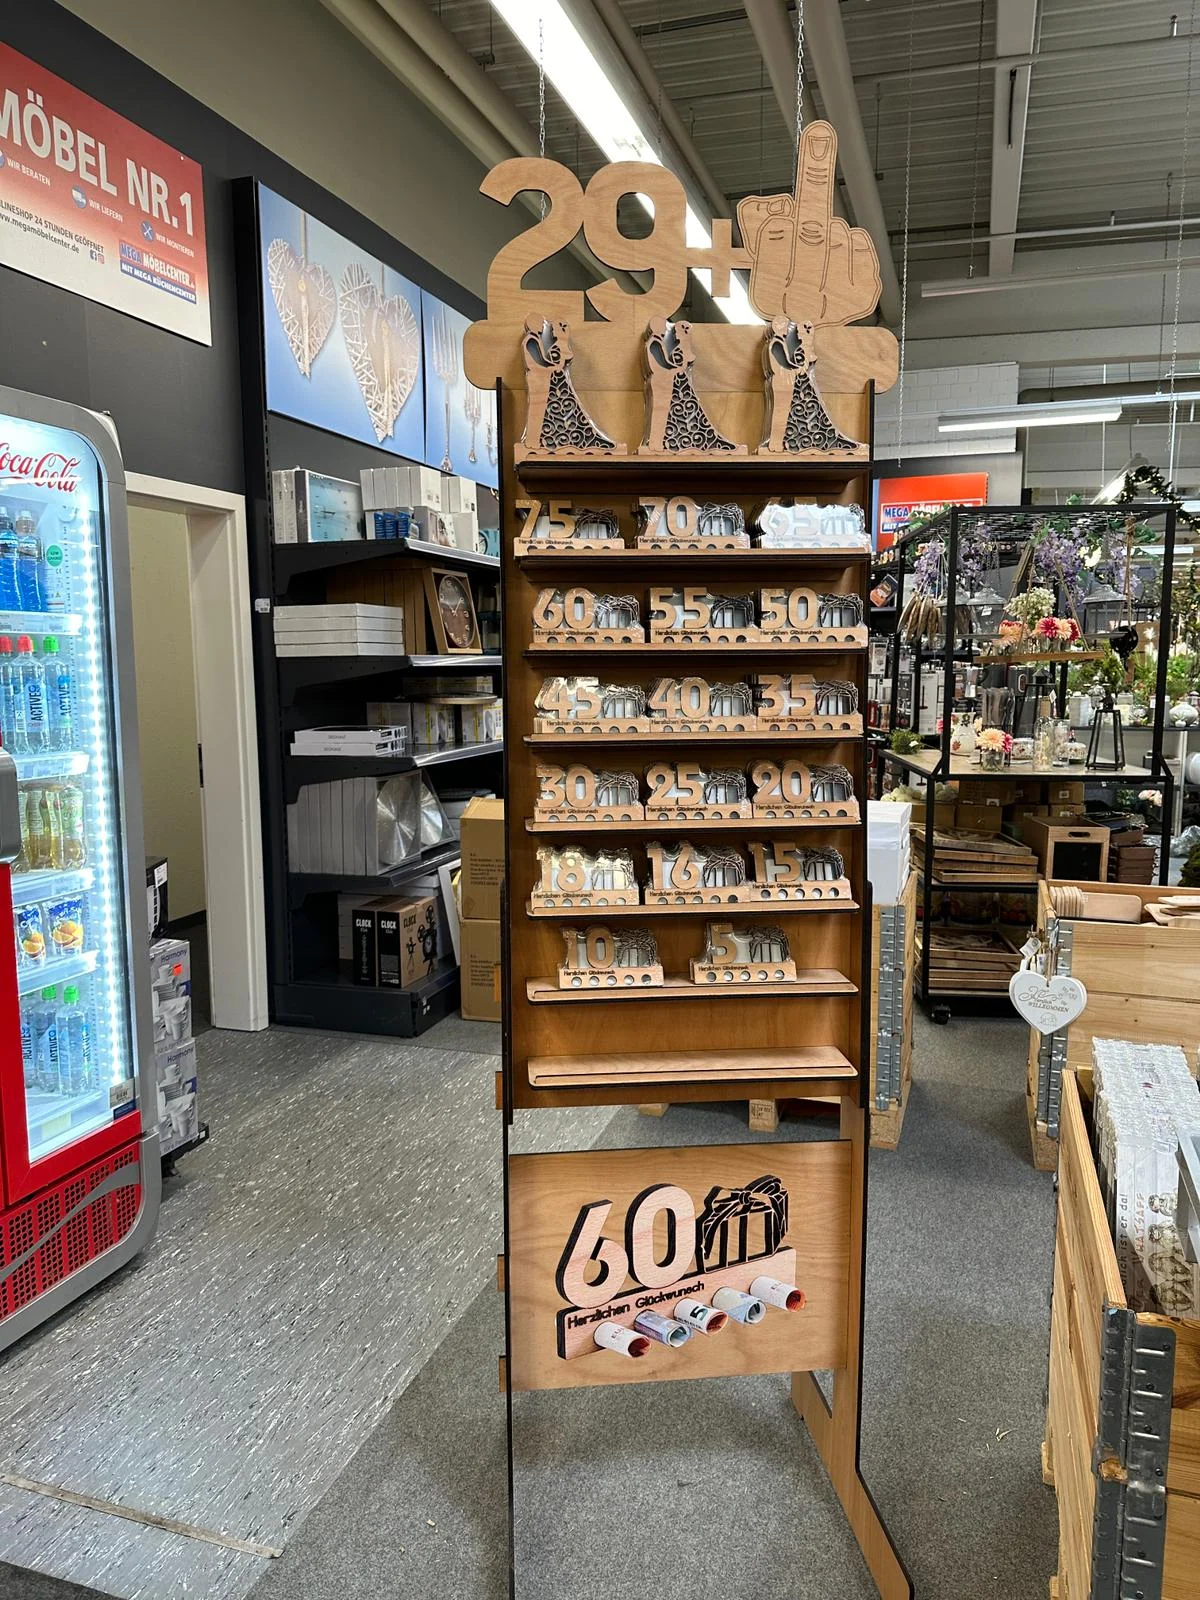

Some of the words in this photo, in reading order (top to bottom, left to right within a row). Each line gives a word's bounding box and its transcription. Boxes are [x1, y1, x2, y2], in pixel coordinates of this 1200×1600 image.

[7, 157, 20, 172] WIR
[21, 164, 51, 187] BERATEN
[101, 205, 123, 223] LIEFERN
[126, 157, 194, 237] NR.1
[34, 215, 43, 227] 24
[44, 220, 74, 240] STUNDEN
[74, 234, 104, 253] GEÖFFNET
[121, 242, 142, 264] MEGA
[121, 262, 134, 274] MIT
[134, 268, 152, 283] MEGA
[516, 499, 576, 538] 75
[638, 496, 698, 537] 70
[884, 506, 909, 519] MEGA
[533, 587, 594, 629] 60
[650, 587, 711, 629] 55
[760, 587, 819, 629] 50
[541, 676, 602, 719] 45
[649, 676, 711, 719] 40
[757, 674, 816, 717] 35
[536, 764, 596, 808] 30
[646, 762, 705, 806] 25
[752, 761, 812, 804] 20
[536, 848, 586, 892] 18
[647, 845, 699, 890] 16
[748, 841, 800, 882] 15
[356, 918, 372, 928] CLOCK
[380, 919, 397, 929] CLOCK
[403, 913, 417, 929] CLOCK
[562, 926, 616, 969] 10
[710, 922, 737, 965] 5
[1118, 1193, 1128, 1211] da!
[1119, 1215, 1128, 1229] er
[555, 1183, 696, 1309] 60
[1118, 1233, 1128, 1250] ist
[567, 1302, 630, 1330] Herzlichen
[635, 1280, 705, 1311] Glückwunsch
